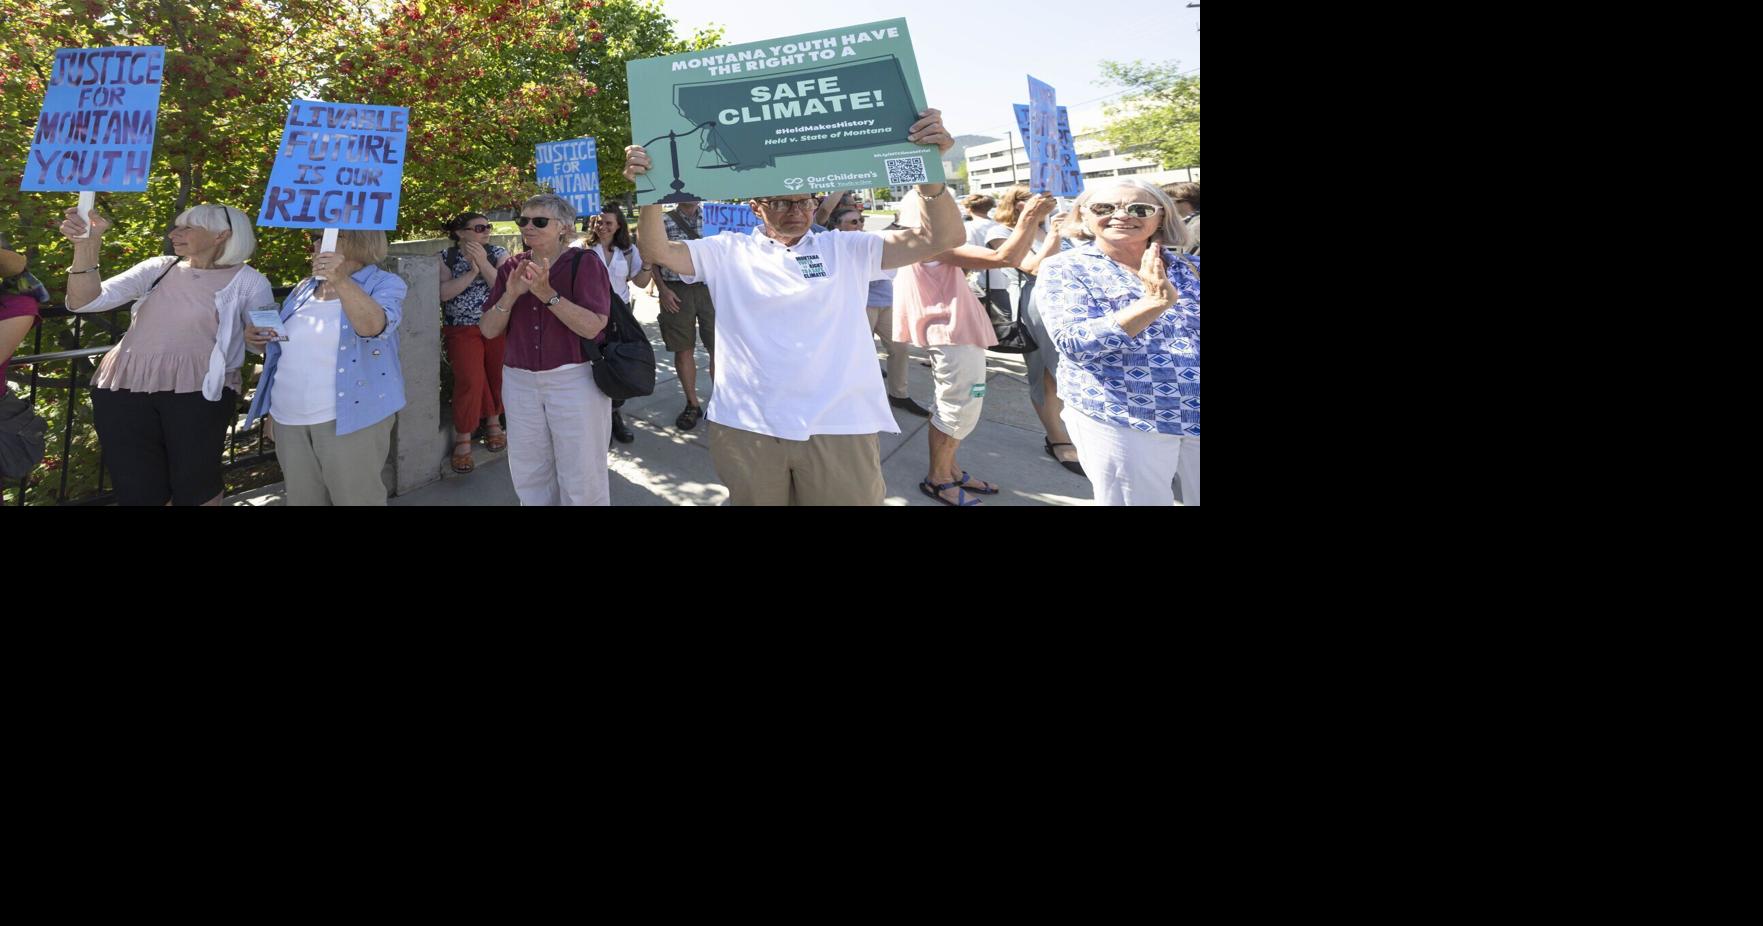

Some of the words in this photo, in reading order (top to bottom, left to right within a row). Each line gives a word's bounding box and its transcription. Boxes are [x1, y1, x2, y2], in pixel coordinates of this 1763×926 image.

[672, 49, 765, 71] MONTANA
[769, 37, 837, 56] YOUTH
[842, 26, 900, 45] HAVE
[708, 60, 743, 77] THE
[746, 52, 806, 72] RIGHT
[808, 49, 836, 62] TO
[840, 46, 857, 58] A
[51, 49, 162, 86] JUSTICE
[78, 86, 124, 107] FOR
[750, 75, 841, 103] SAFE
[290, 105, 404, 133] LIVABLE
[718, 89, 885, 126] CLIMATE!
[36, 110, 153, 145] MONTANA
[764, 135, 787, 145] Held
[800, 133, 828, 142] State
[830, 131, 841, 139] of
[843, 126, 892, 137] Montana
[775, 118, 876, 135] #HeldMakesHistory
[284, 131, 399, 165] FUTURE
[536, 140, 596, 164] JUSTICE
[35, 149, 148, 185] YOUTH
[294, 164, 325, 184] IS
[336, 166, 383, 187] OUR
[553, 160, 580, 174] FOR
[827, 171, 877, 181] Children's
[808, 181, 835, 189] Trust
[264, 186, 392, 224] RIGHT
[703, 205, 757, 227] JUSTIC
